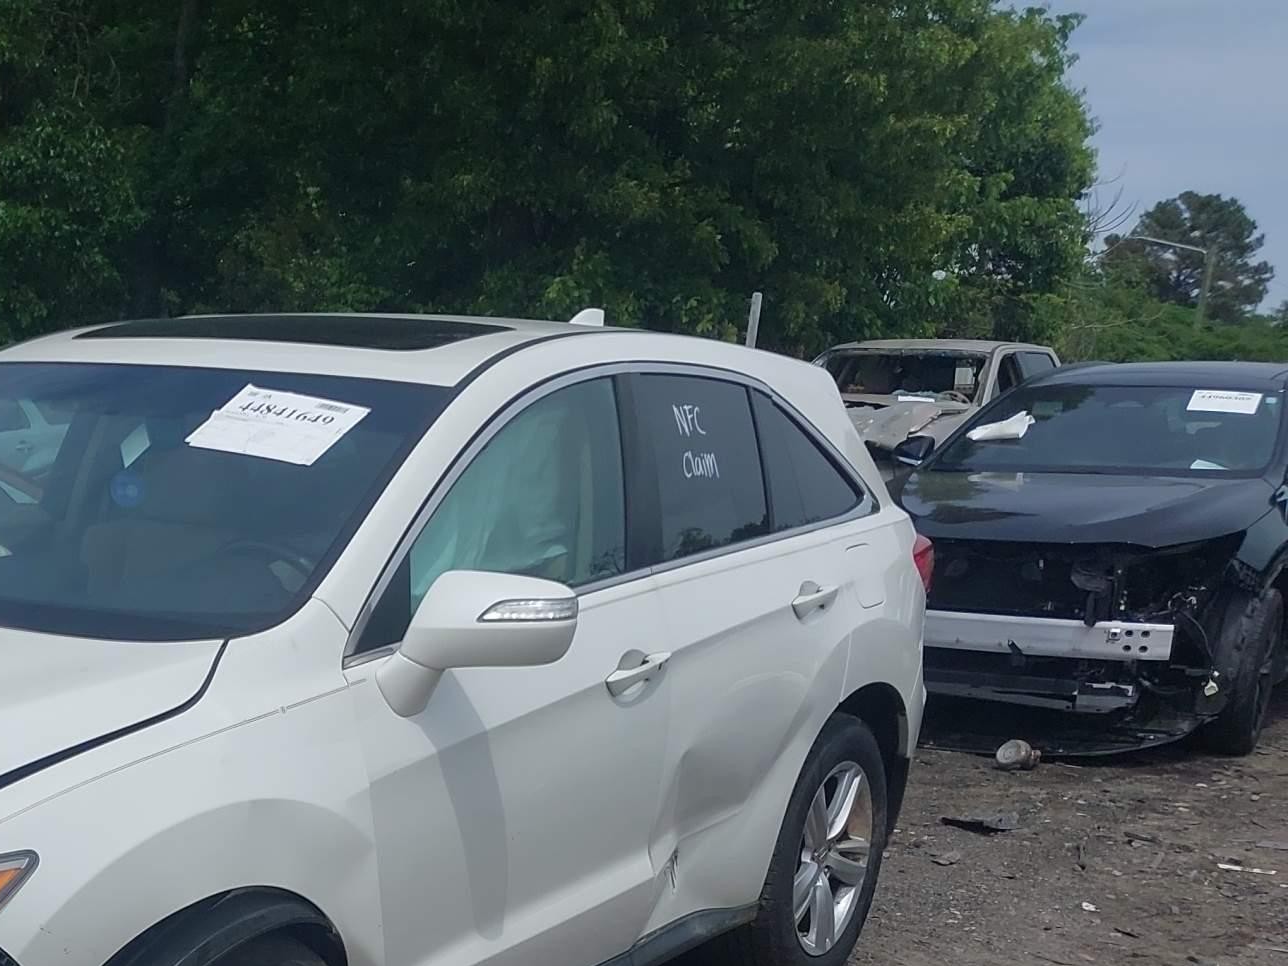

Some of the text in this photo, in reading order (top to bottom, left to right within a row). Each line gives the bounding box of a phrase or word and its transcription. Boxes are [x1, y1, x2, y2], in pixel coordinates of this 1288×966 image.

[239, 400, 334, 425] 44841649
[672, 404, 706, 437] NFC
[683, 450, 719, 479] Claim
